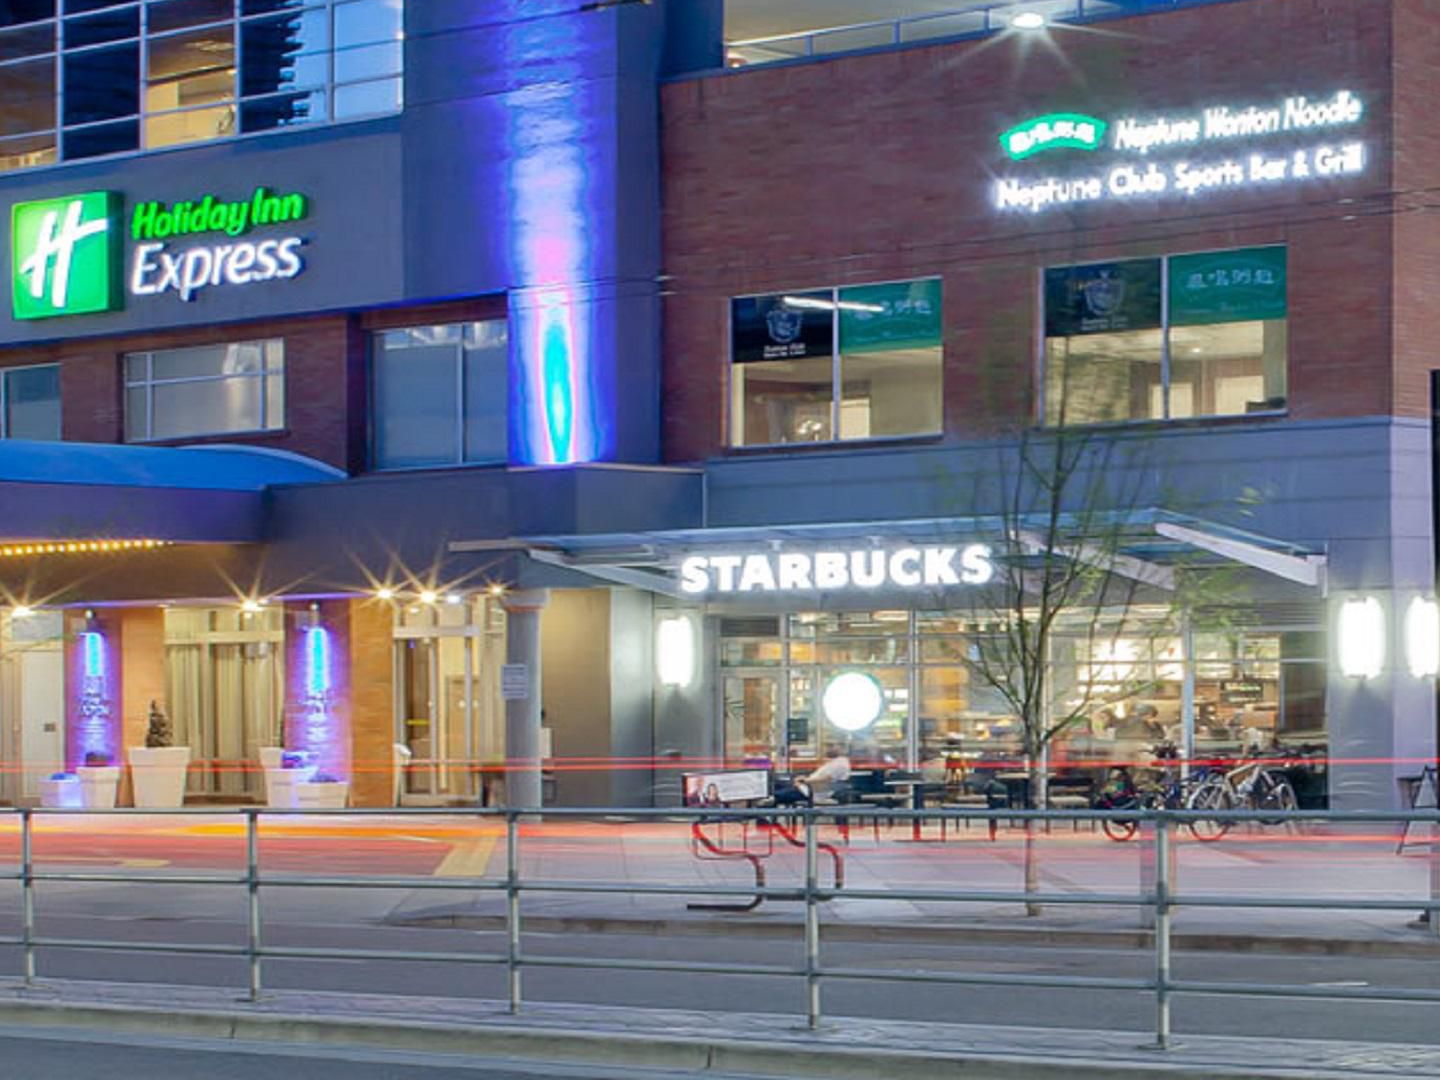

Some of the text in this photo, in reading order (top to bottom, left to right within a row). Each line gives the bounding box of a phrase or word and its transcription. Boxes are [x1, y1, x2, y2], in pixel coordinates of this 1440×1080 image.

[1113, 117, 1199, 153] Neptune
[1282, 89, 1363, 131] Noodle
[997, 141, 1363, 212] Neptune Club Sports Bar & Grill
[131, 186, 305, 239] Holiday Inn
[131, 237, 303, 302] Express
[680, 543, 994, 593] STARBUCKS
